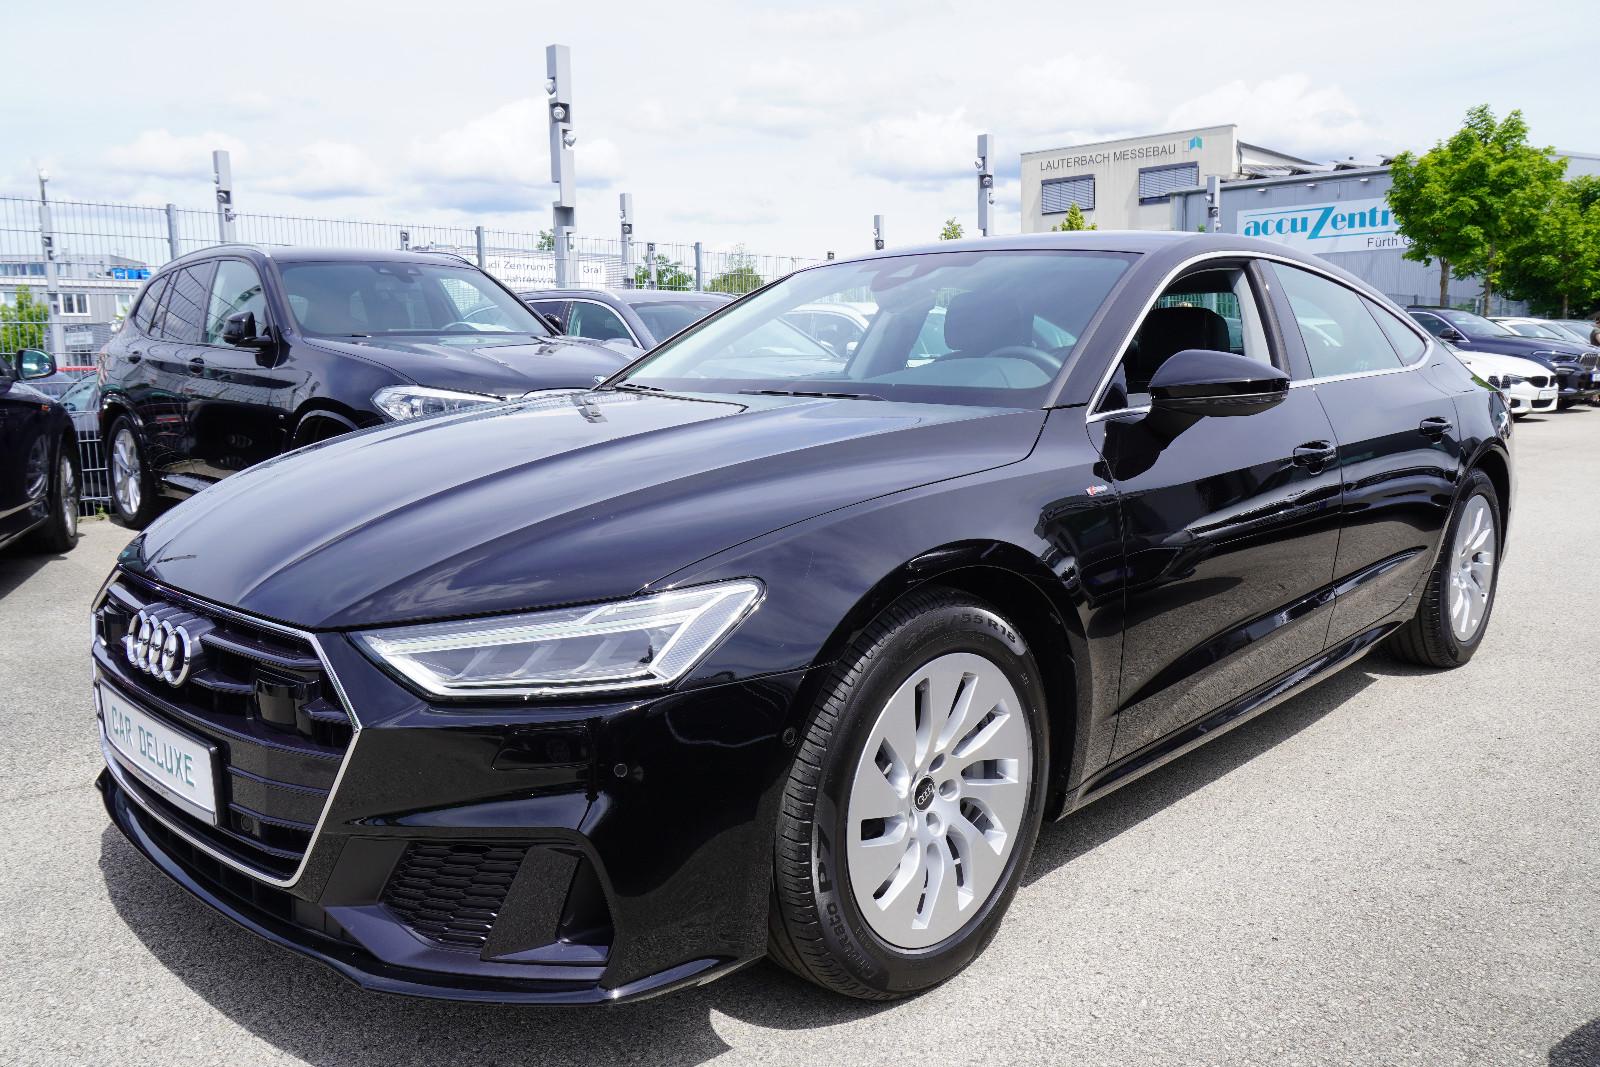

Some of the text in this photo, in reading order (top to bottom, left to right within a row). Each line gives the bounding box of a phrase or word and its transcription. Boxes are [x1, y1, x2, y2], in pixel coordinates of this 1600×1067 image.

[1040, 143, 1176, 171] LAUTERBACH MESSEBAU
[1367, 237, 1398, 248] Fürth
[503, 260, 546, 271] Zentrum
[111, 706, 195, 787] CAR DELUXE
